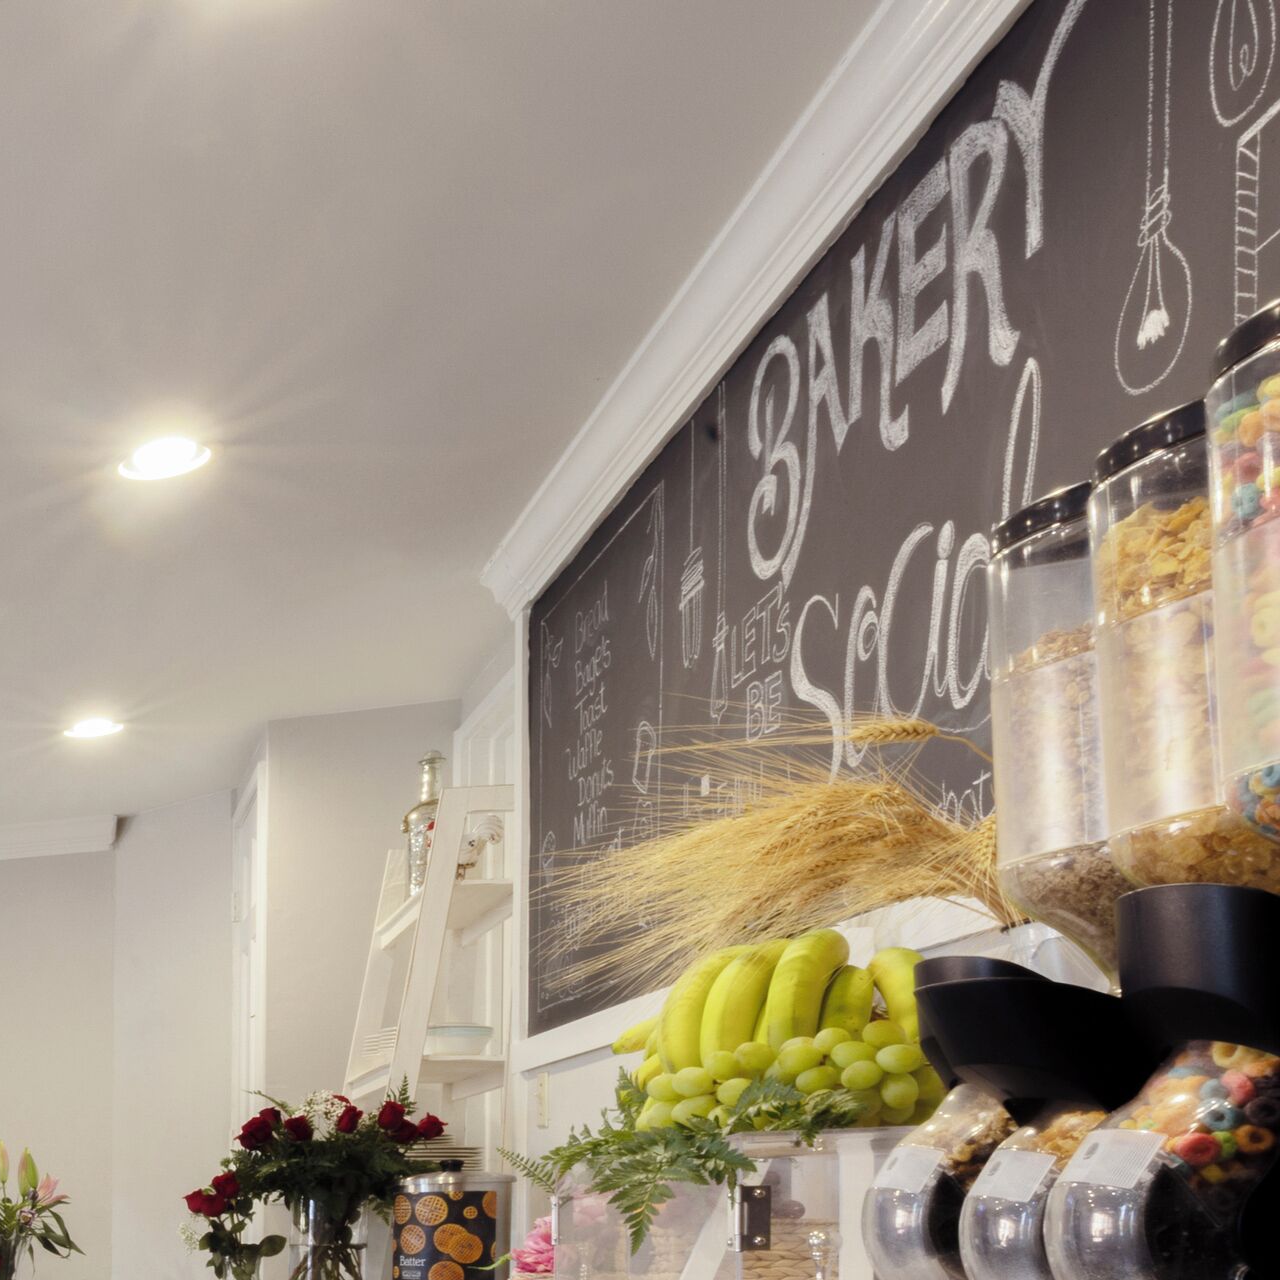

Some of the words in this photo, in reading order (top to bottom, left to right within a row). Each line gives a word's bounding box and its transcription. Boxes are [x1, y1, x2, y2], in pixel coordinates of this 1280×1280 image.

[747, 0, 1088, 596] BAKERY
[575, 580, 609, 653] Bread
[574, 635, 612, 696] Bagels
[574, 682, 608, 736] Toast
[746, 670, 783, 743] BE
[566, 728, 604, 780] Waffle
[400, 1255, 427, 1267] Batter
